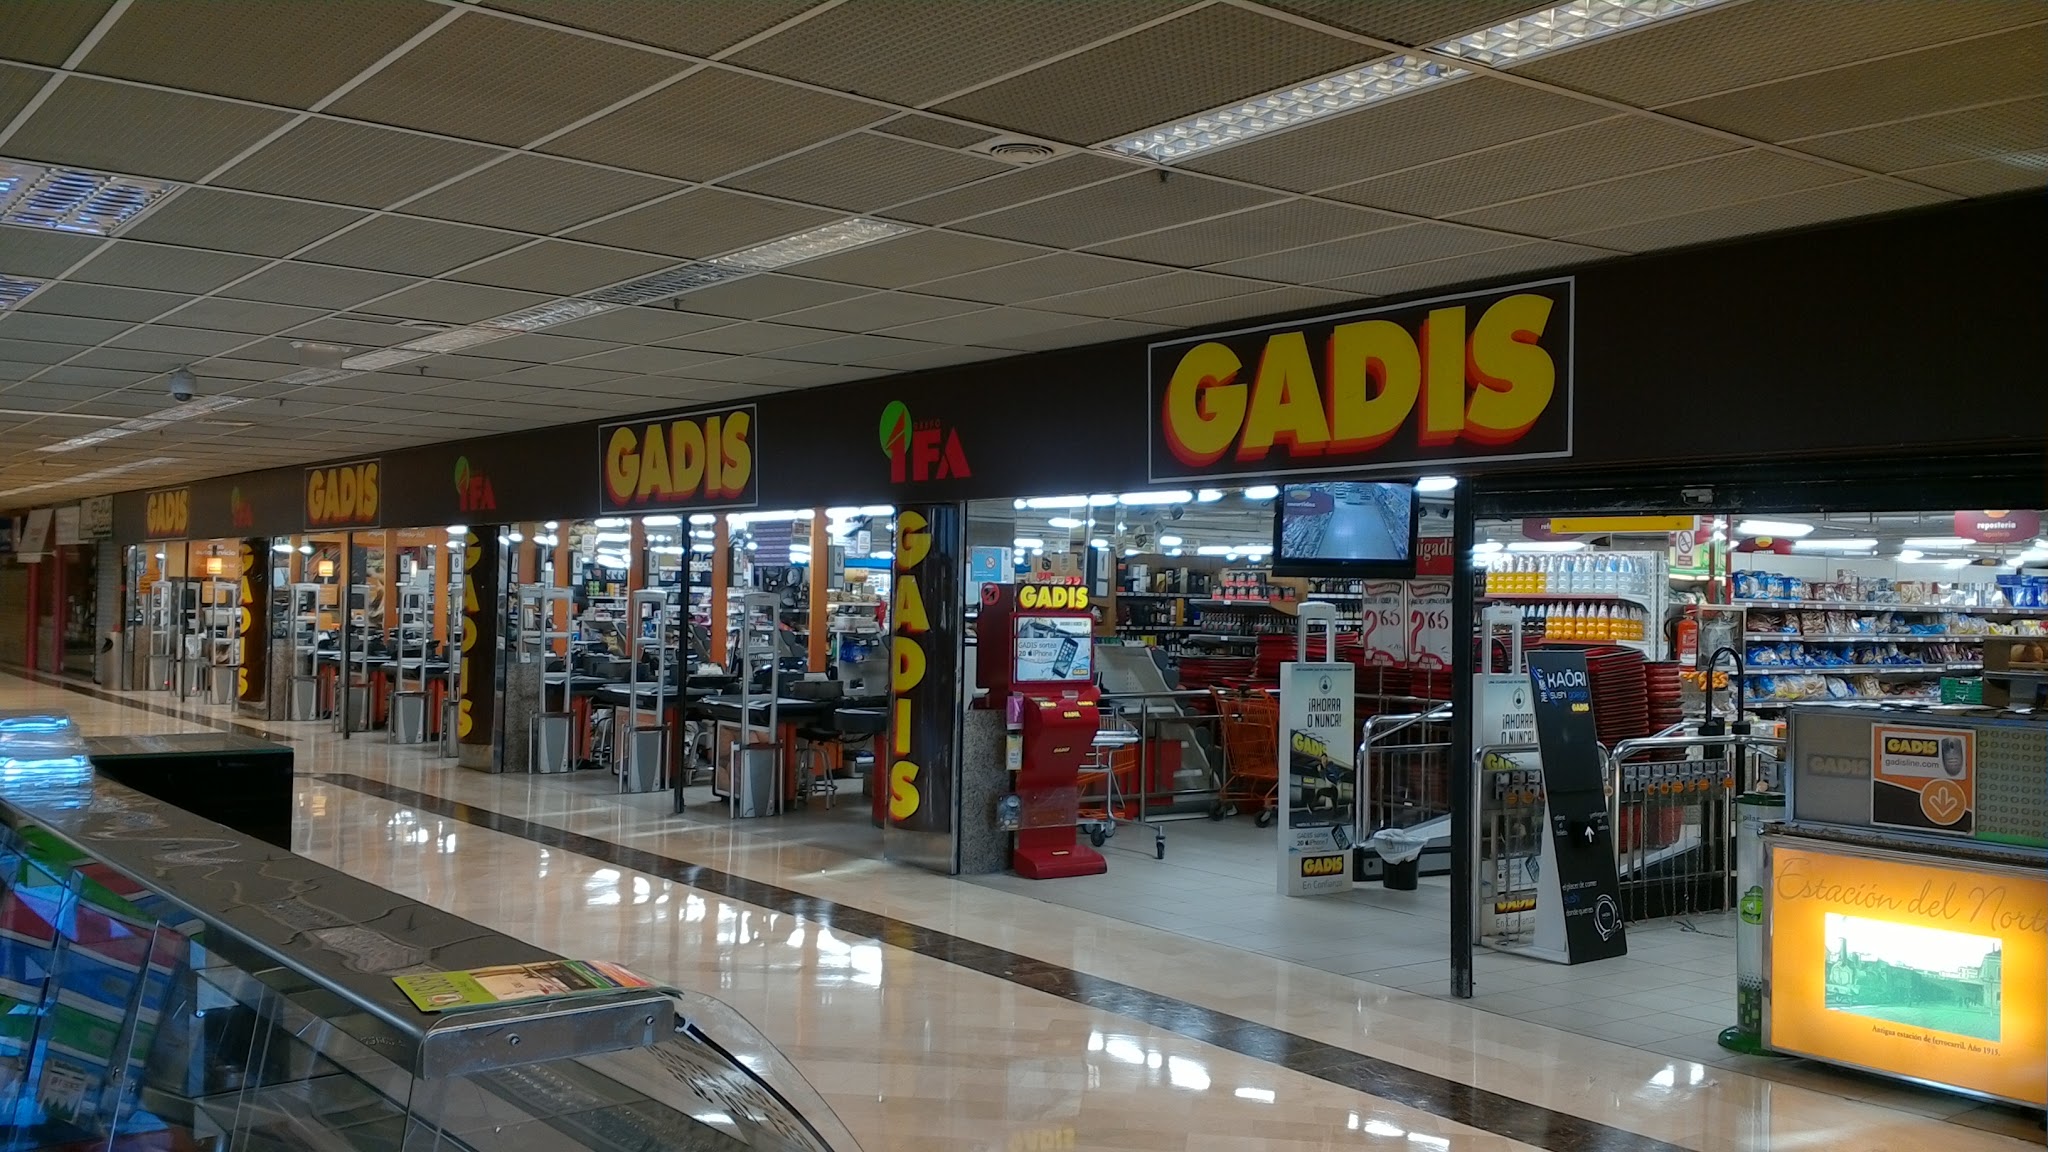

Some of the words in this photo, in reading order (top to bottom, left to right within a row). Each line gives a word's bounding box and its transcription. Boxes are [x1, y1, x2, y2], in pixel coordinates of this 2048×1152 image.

[1163, 293, 1556, 467] GADIS
[606, 411, 752, 506] GADIS
[307, 463, 379, 525] GADIS
[146, 490, 188, 536] GADIS
[402, 559, 408, 569] 9
[454, 558, 460, 569] 8
[575, 557, 581, 568] 6
[651, 554, 657, 566] 5
[836, 551, 843, 563] 3
[1019, 585, 1090, 611] GADIS
[888, 510, 932, 821] GADIS
[1308, 697, 1341, 712] ¡AHORRA
[1571, 702, 1590, 712] GADIS
[1307, 713, 1313, 728] O
[1315, 713, 1342, 728] NUNCA!
[1502, 713, 1534, 729] ¡AHORRA
[1887, 738, 1938, 755] GADIS
[1809, 755, 1870, 775] GADIS
[1884, 757, 1940, 769] gadisline.com
[1303, 857, 1343, 876] GADIS
[1302, 881, 1312, 890] En
[1313, 880, 1343, 889] Confianza
[1775, 858, 1903, 911] Estación
[1908, 879, 1962, 921] del
[1496, 918, 1505, 929] En
[1872, 1024, 1896, 1036] Antigua
[1897, 1029, 1922, 1042] estación
[1923, 1034, 1931, 1044] de
[1967, 1043, 1982, 1053] Año
[1983, 1046, 2001, 1057] 1915.
